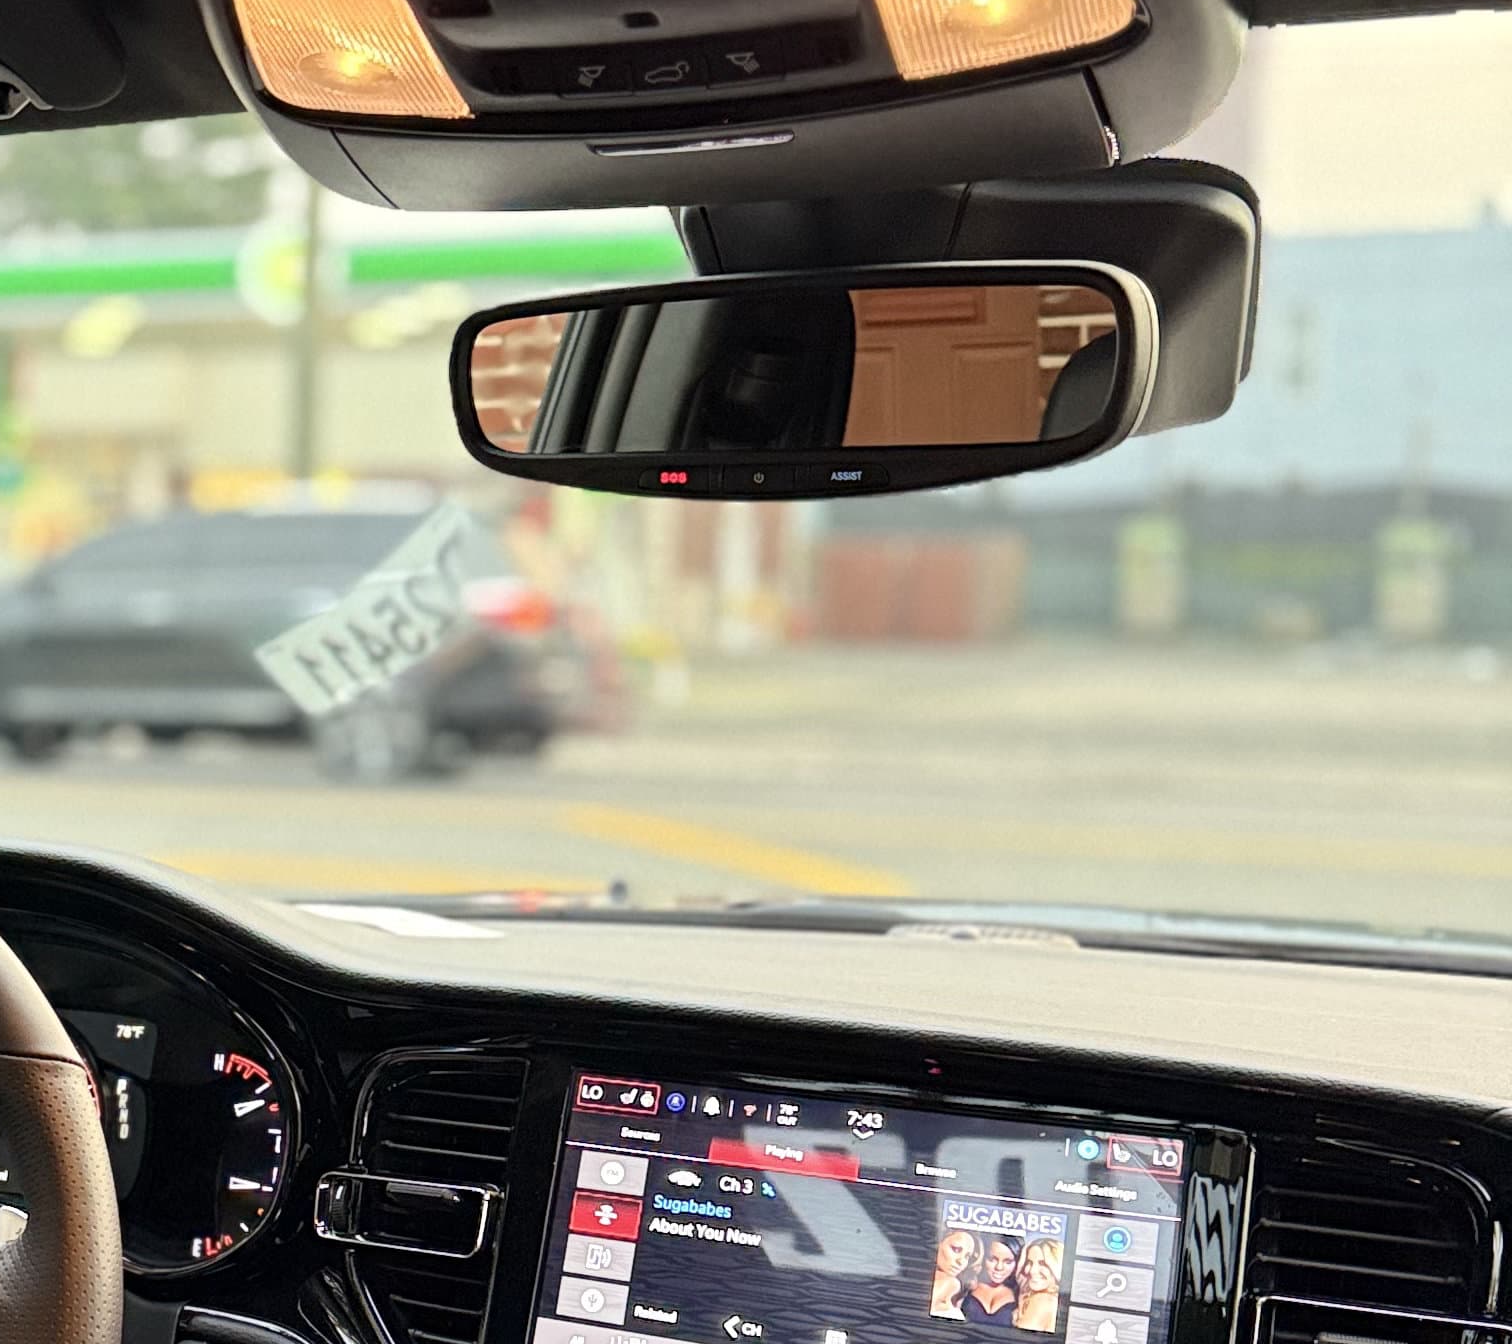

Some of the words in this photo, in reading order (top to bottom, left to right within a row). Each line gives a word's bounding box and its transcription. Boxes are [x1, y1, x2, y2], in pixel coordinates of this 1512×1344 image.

[660, 471, 687, 484] SOS
[831, 471, 863, 482] ASSIST
[214, 1054, 225, 1072] H
[581, 1084, 604, 1101] LO
[846, 1109, 883, 1129] 7:43
[764, 1144, 804, 1162] Playing
[1152, 1148, 1179, 1168] LO
[915, 1162, 957, 1179] Browse
[718, 1175, 741, 1193] Ch
[742, 1179, 754, 1195] 3
[1054, 1180, 1089, 1197] Audio
[1089, 1182, 1138, 1202] Settings
[653, 1194, 733, 1219] Sugababes
[947, 1204, 1063, 1235] SUGABABES
[649, 1217, 694, 1237] About
[695, 1222, 724, 1243] You
[726, 1227, 763, 1247] Now
[192, 1238, 203, 1257] E
[741, 1322, 763, 1338] CH
